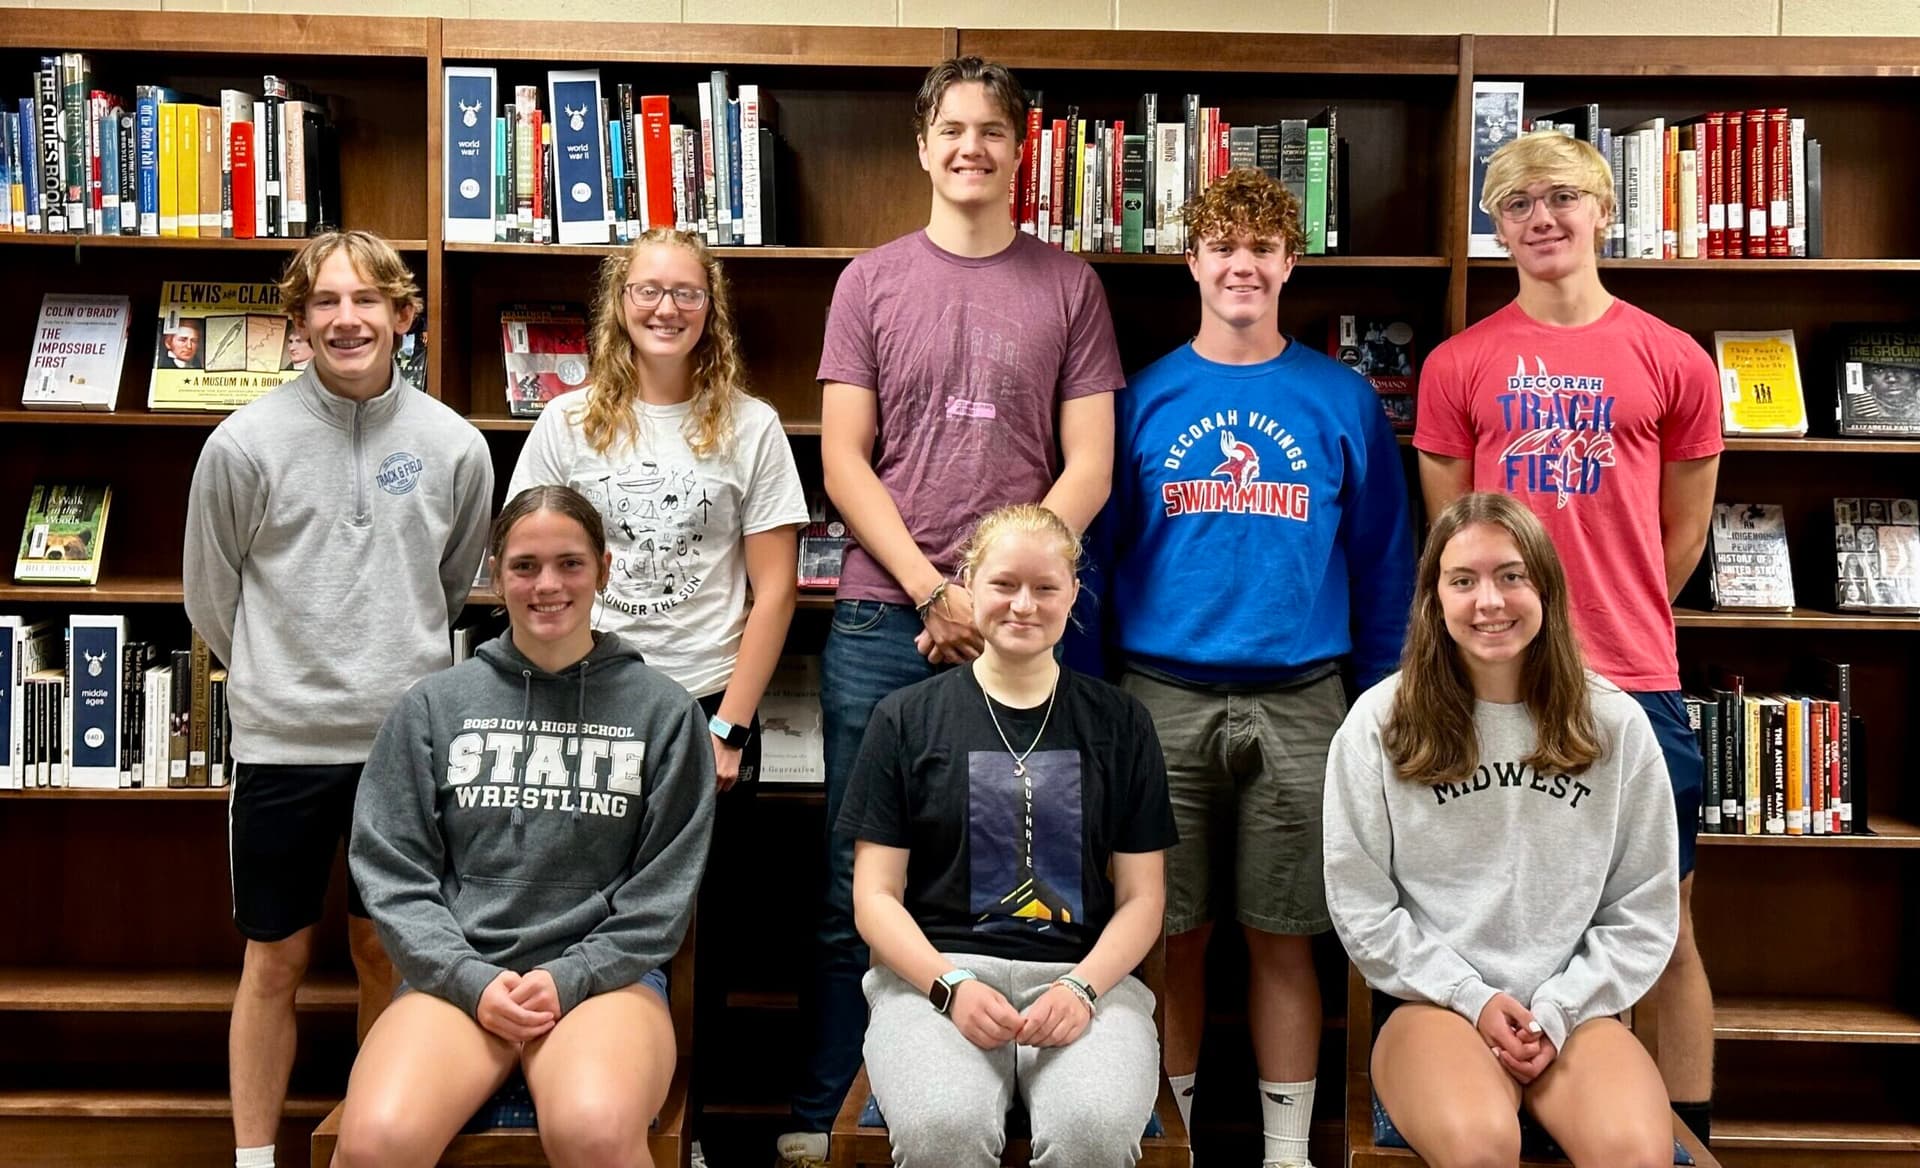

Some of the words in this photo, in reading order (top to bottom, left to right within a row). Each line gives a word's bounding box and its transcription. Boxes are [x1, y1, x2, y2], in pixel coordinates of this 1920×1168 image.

[41, 65, 56, 103] THE
[42, 104, 58, 162] CITIES
[141, 127, 154, 149] Beaten
[458, 140, 480, 148] world
[567, 143, 588, 152] world
[687, 134, 695, 159] WORLD
[744, 132, 757, 170] World
[141, 150, 154, 166] Path
[569, 152, 583, 160] war
[45, 164, 61, 215] BOOK
[745, 174, 757, 200] War
[1628, 167, 1638, 209] CAPTURED
[169, 283, 222, 304] LEWIS
[238, 285, 283, 304] CLAR
[45, 306, 75, 317] COLIN
[76, 307, 120, 319] O'BRADY
[41, 328, 62, 340] THE
[37, 342, 107, 355] IMPOSSIBLE
[1872, 346, 1920, 357] GROUN
[34, 356, 67, 368] FIRST
[193, 376, 199, 387] A
[201, 376, 237, 387] MUSEUM
[239, 376, 249, 387] IN
[252, 376, 259, 387] A
[1508, 376, 1603, 391] DECORAH
[1496, 393, 1616, 433] TRACK
[1164, 410, 1239, 470] DECORAH
[1248, 411, 1308, 472] VIKINGS
[1549, 434, 1563, 448] &
[376, 468, 399, 488] TRACK
[403, 458, 423, 477] FIELD
[1505, 454, 1603, 495] FIELD
[59, 496, 83, 505] Walk
[62, 505, 77, 515] the
[1162, 480, 1310, 522] SWIMMING
[45, 515, 80, 525] Woods
[1743, 521, 1755, 529] AN
[1718, 554, 1753, 563] HISTORY
[1721, 565, 1752, 575] UNITED
[605, 594, 647, 615] UNDER
[651, 598, 678, 614] THE
[679, 575, 702, 600] SUN
[81, 689, 108, 698] middle
[85, 698, 104, 706] ages
[463, 718, 499, 730] 2023
[500, 718, 538, 731] IOWA
[541, 721, 577, 734] HIGH
[581, 723, 635, 738] SCHOOL
[1774, 727, 1784, 746] THE
[1830, 740, 1839, 763] CUBA
[447, 732, 647, 796] STATE
[1774, 748, 1783, 790] ANCIENT
[1431, 761, 1592, 809] MIDWEST
[1711, 767, 1719, 795] AMERICA
[455, 786, 628, 818] WRESTLING
[1774, 792, 1783, 819] MAYA
[1024, 776, 1033, 869] GUTHRIE
